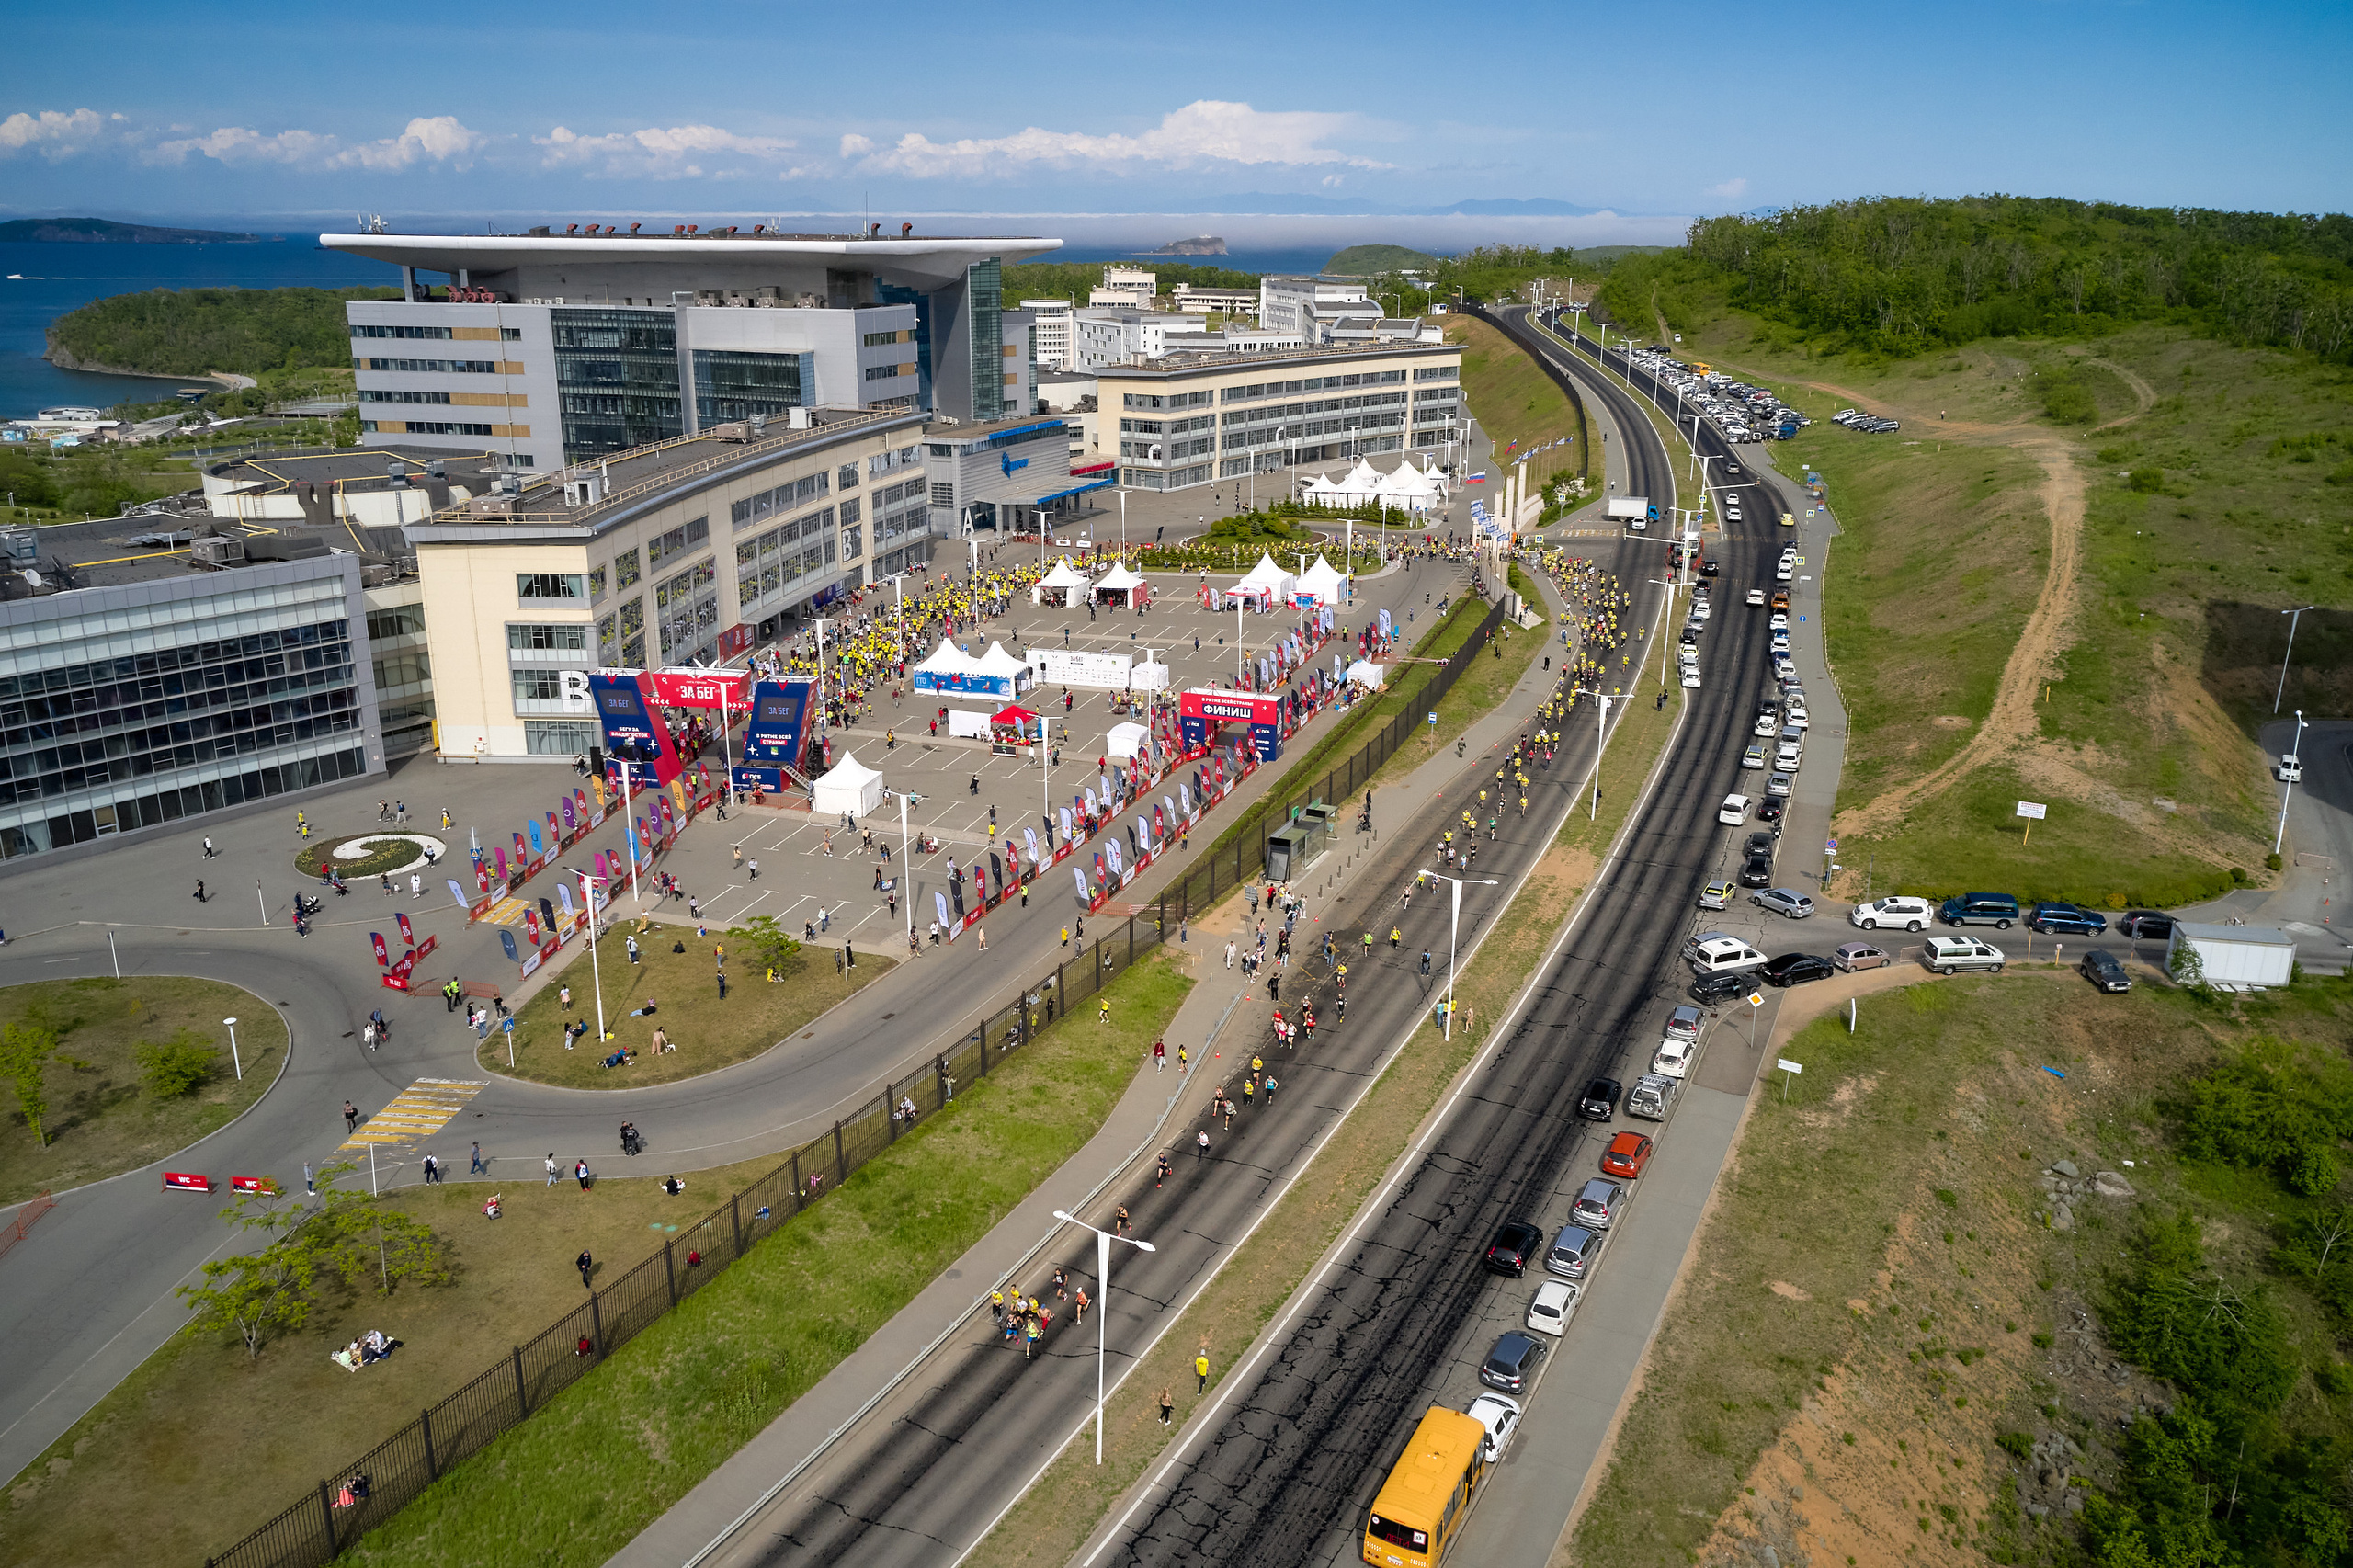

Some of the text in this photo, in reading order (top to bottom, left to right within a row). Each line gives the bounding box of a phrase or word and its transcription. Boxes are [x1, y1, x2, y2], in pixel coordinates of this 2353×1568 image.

[559, 670, 592, 714] B
[697, 687, 716, 699] БЕГ
[1203, 704, 1251, 718] ФИНИШ
[1385, 1533, 1410, 1547] ДЕТИ
